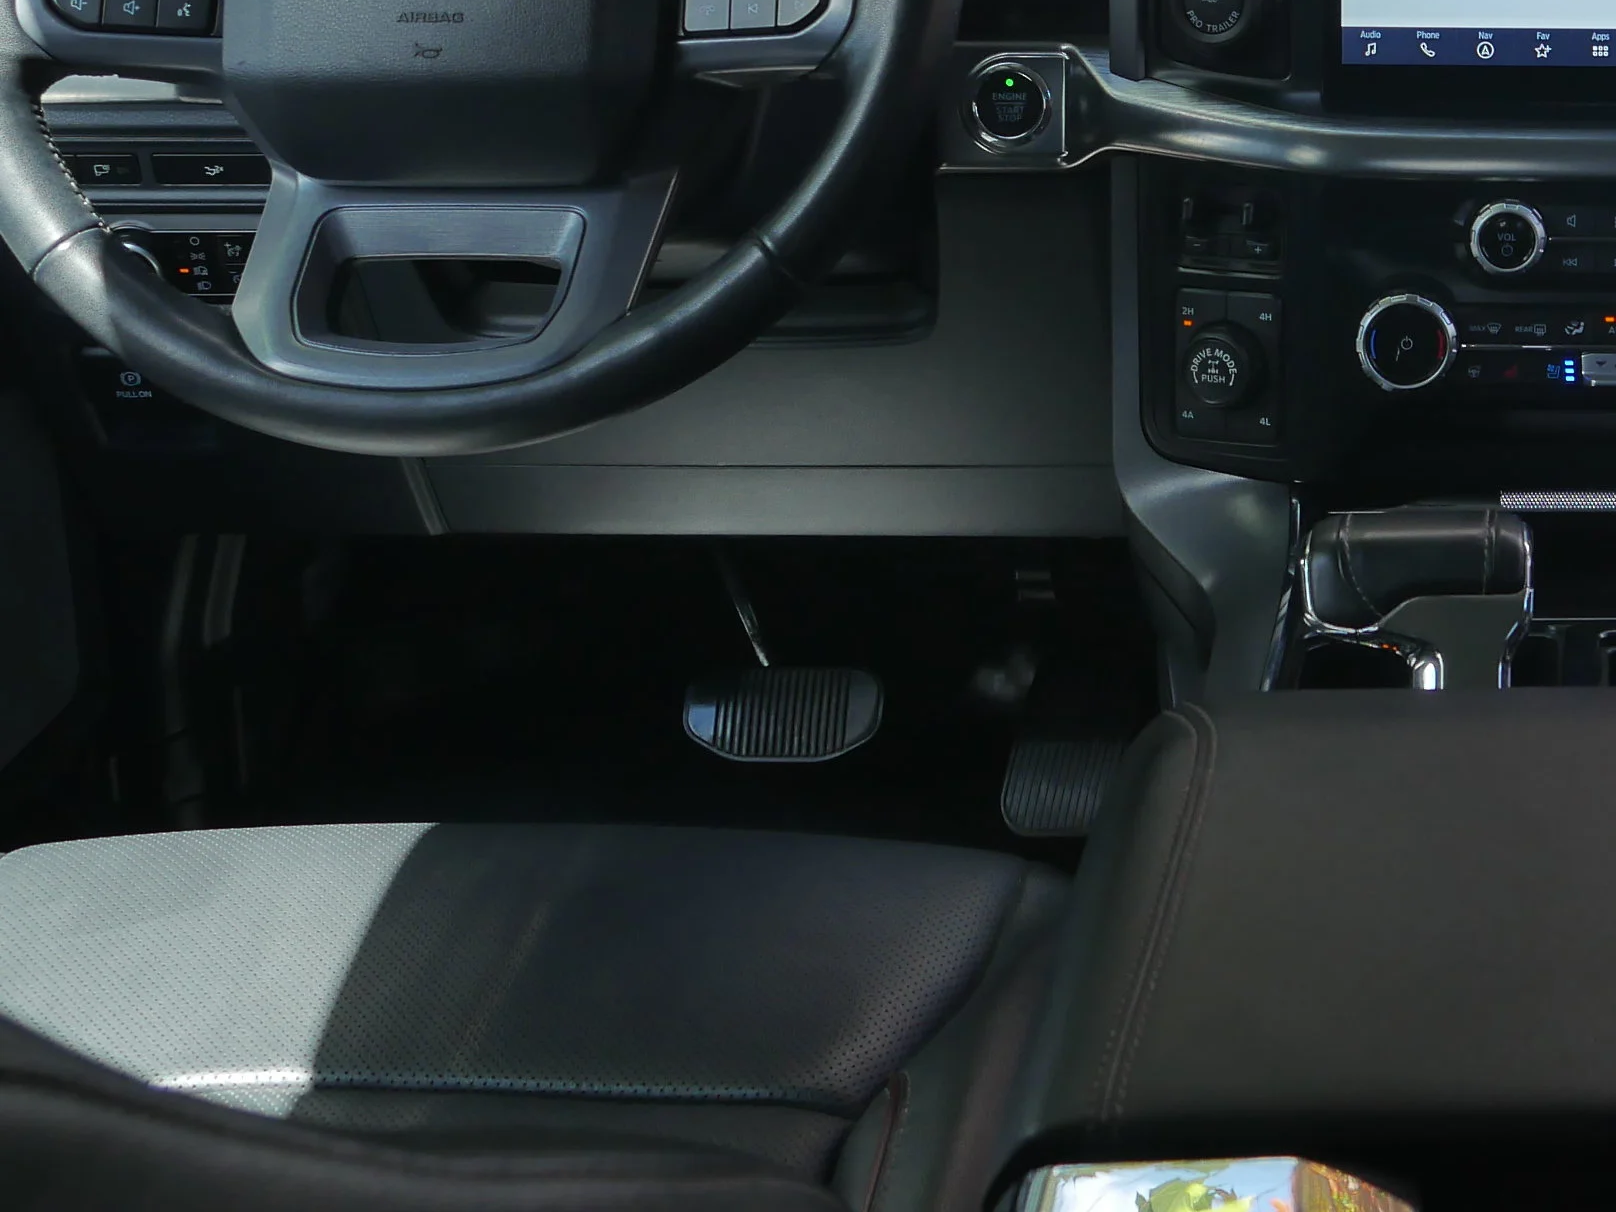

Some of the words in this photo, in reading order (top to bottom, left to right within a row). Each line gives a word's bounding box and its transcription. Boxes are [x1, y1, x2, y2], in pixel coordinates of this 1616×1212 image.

[396, 11, 465, 23] AIRBAG
[1186, 10, 1203, 28] PRO
[1207, 10, 1240, 32] TRAILER
[1360, 30, 1381, 39] Audio
[1416, 31, 1440, 39] Phone
[1478, 31, 1493, 40] Nav
[1536, 31, 1550, 40] Fav
[1591, 32, 1610, 41] Apps
[992, 92, 1027, 101] ENGINE
[1497, 232, 1516, 242] VOL
[1182, 307, 1194, 316] 2H
[1259, 312, 1272, 321] 4H
[1514, 325, 1533, 333] REAR
[1190, 348, 1212, 372] DRIVE
[1214, 348, 1238, 374] MODE
[1201, 374, 1226, 384] PUSH
[1182, 410, 1194, 419] 4A
[1259, 417, 1271, 426] 4L
